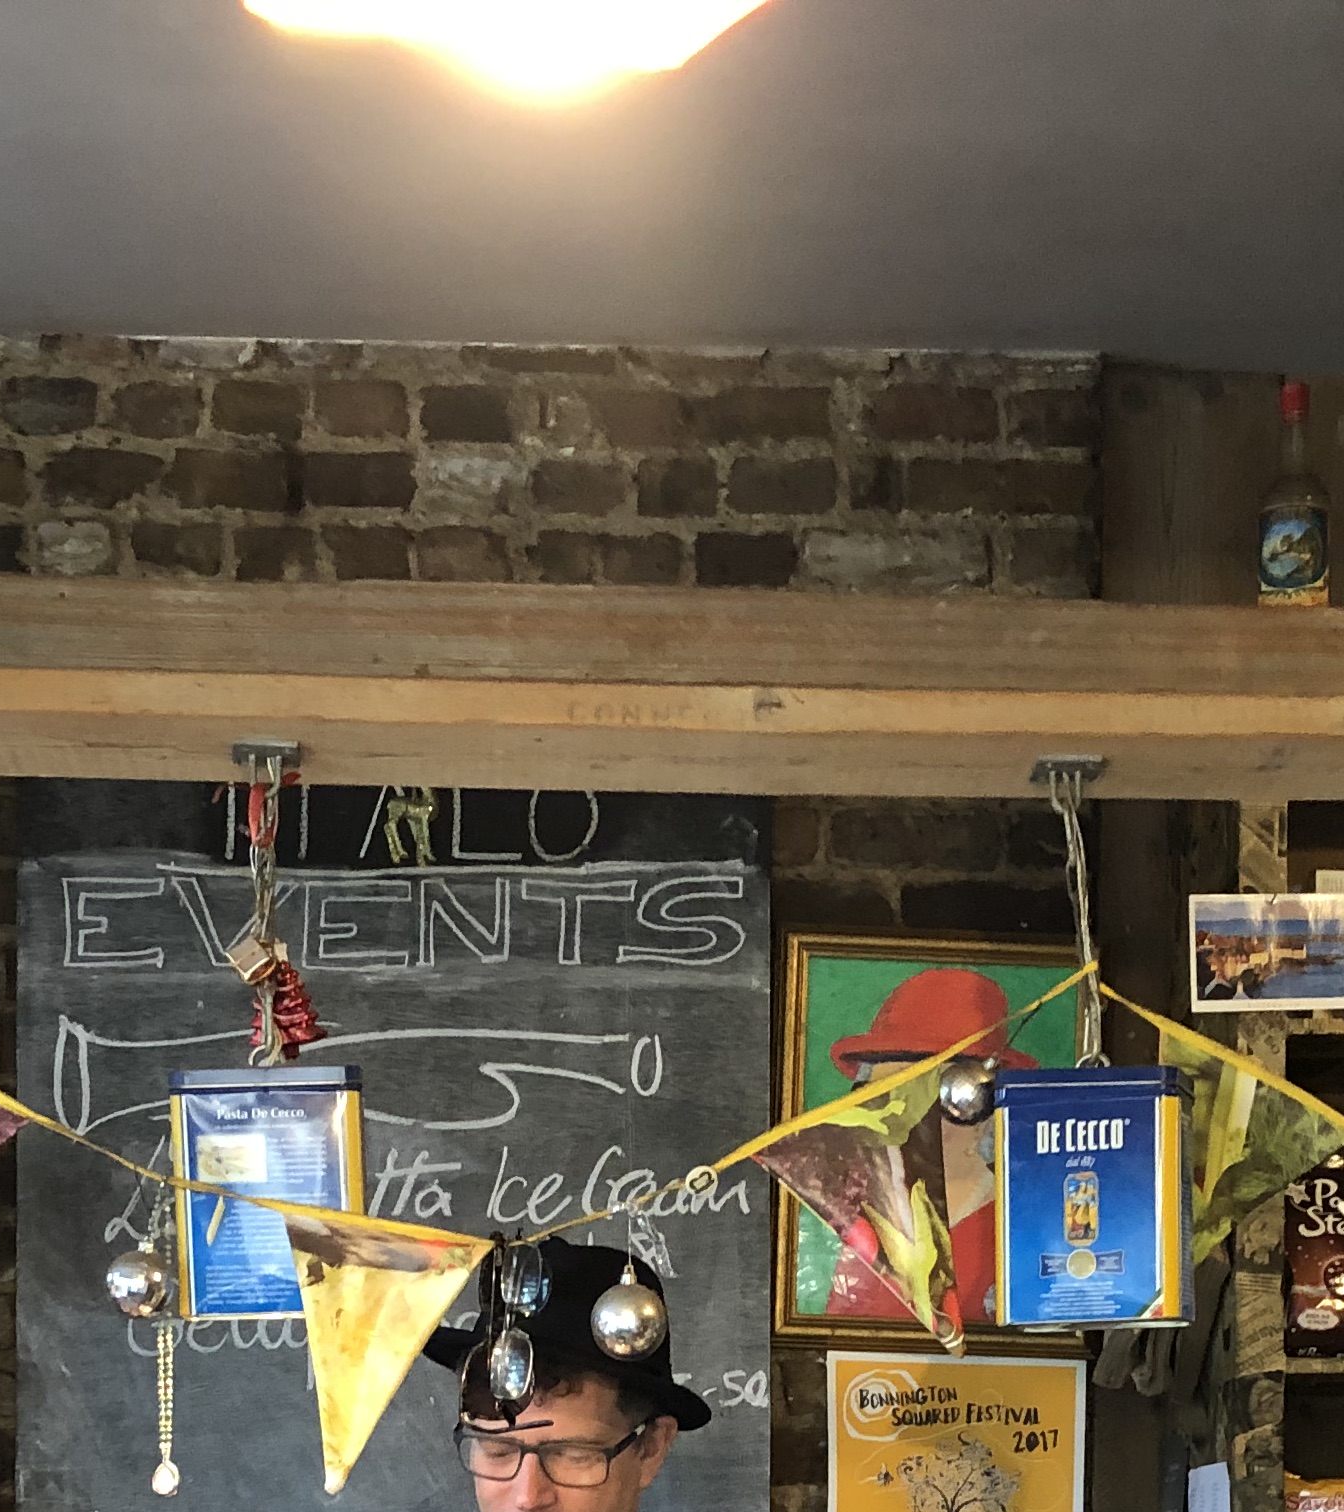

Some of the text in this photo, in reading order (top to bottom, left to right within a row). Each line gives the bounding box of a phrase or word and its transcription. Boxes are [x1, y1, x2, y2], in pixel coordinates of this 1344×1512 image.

[61, 874, 746, 972] EVENTS
[216, 1108, 250, 1120] Pasta
[251, 1108, 269, 1119] De
[1036, 1118, 1124, 1154] DE CECCO
[487, 1146, 572, 1224] Ice
[859, 1386, 958, 1409] BONNINGTON
[891, 1403, 1041, 1427] SQUARED FESTIVAL
[1012, 1429, 1059, 1453] 2017
